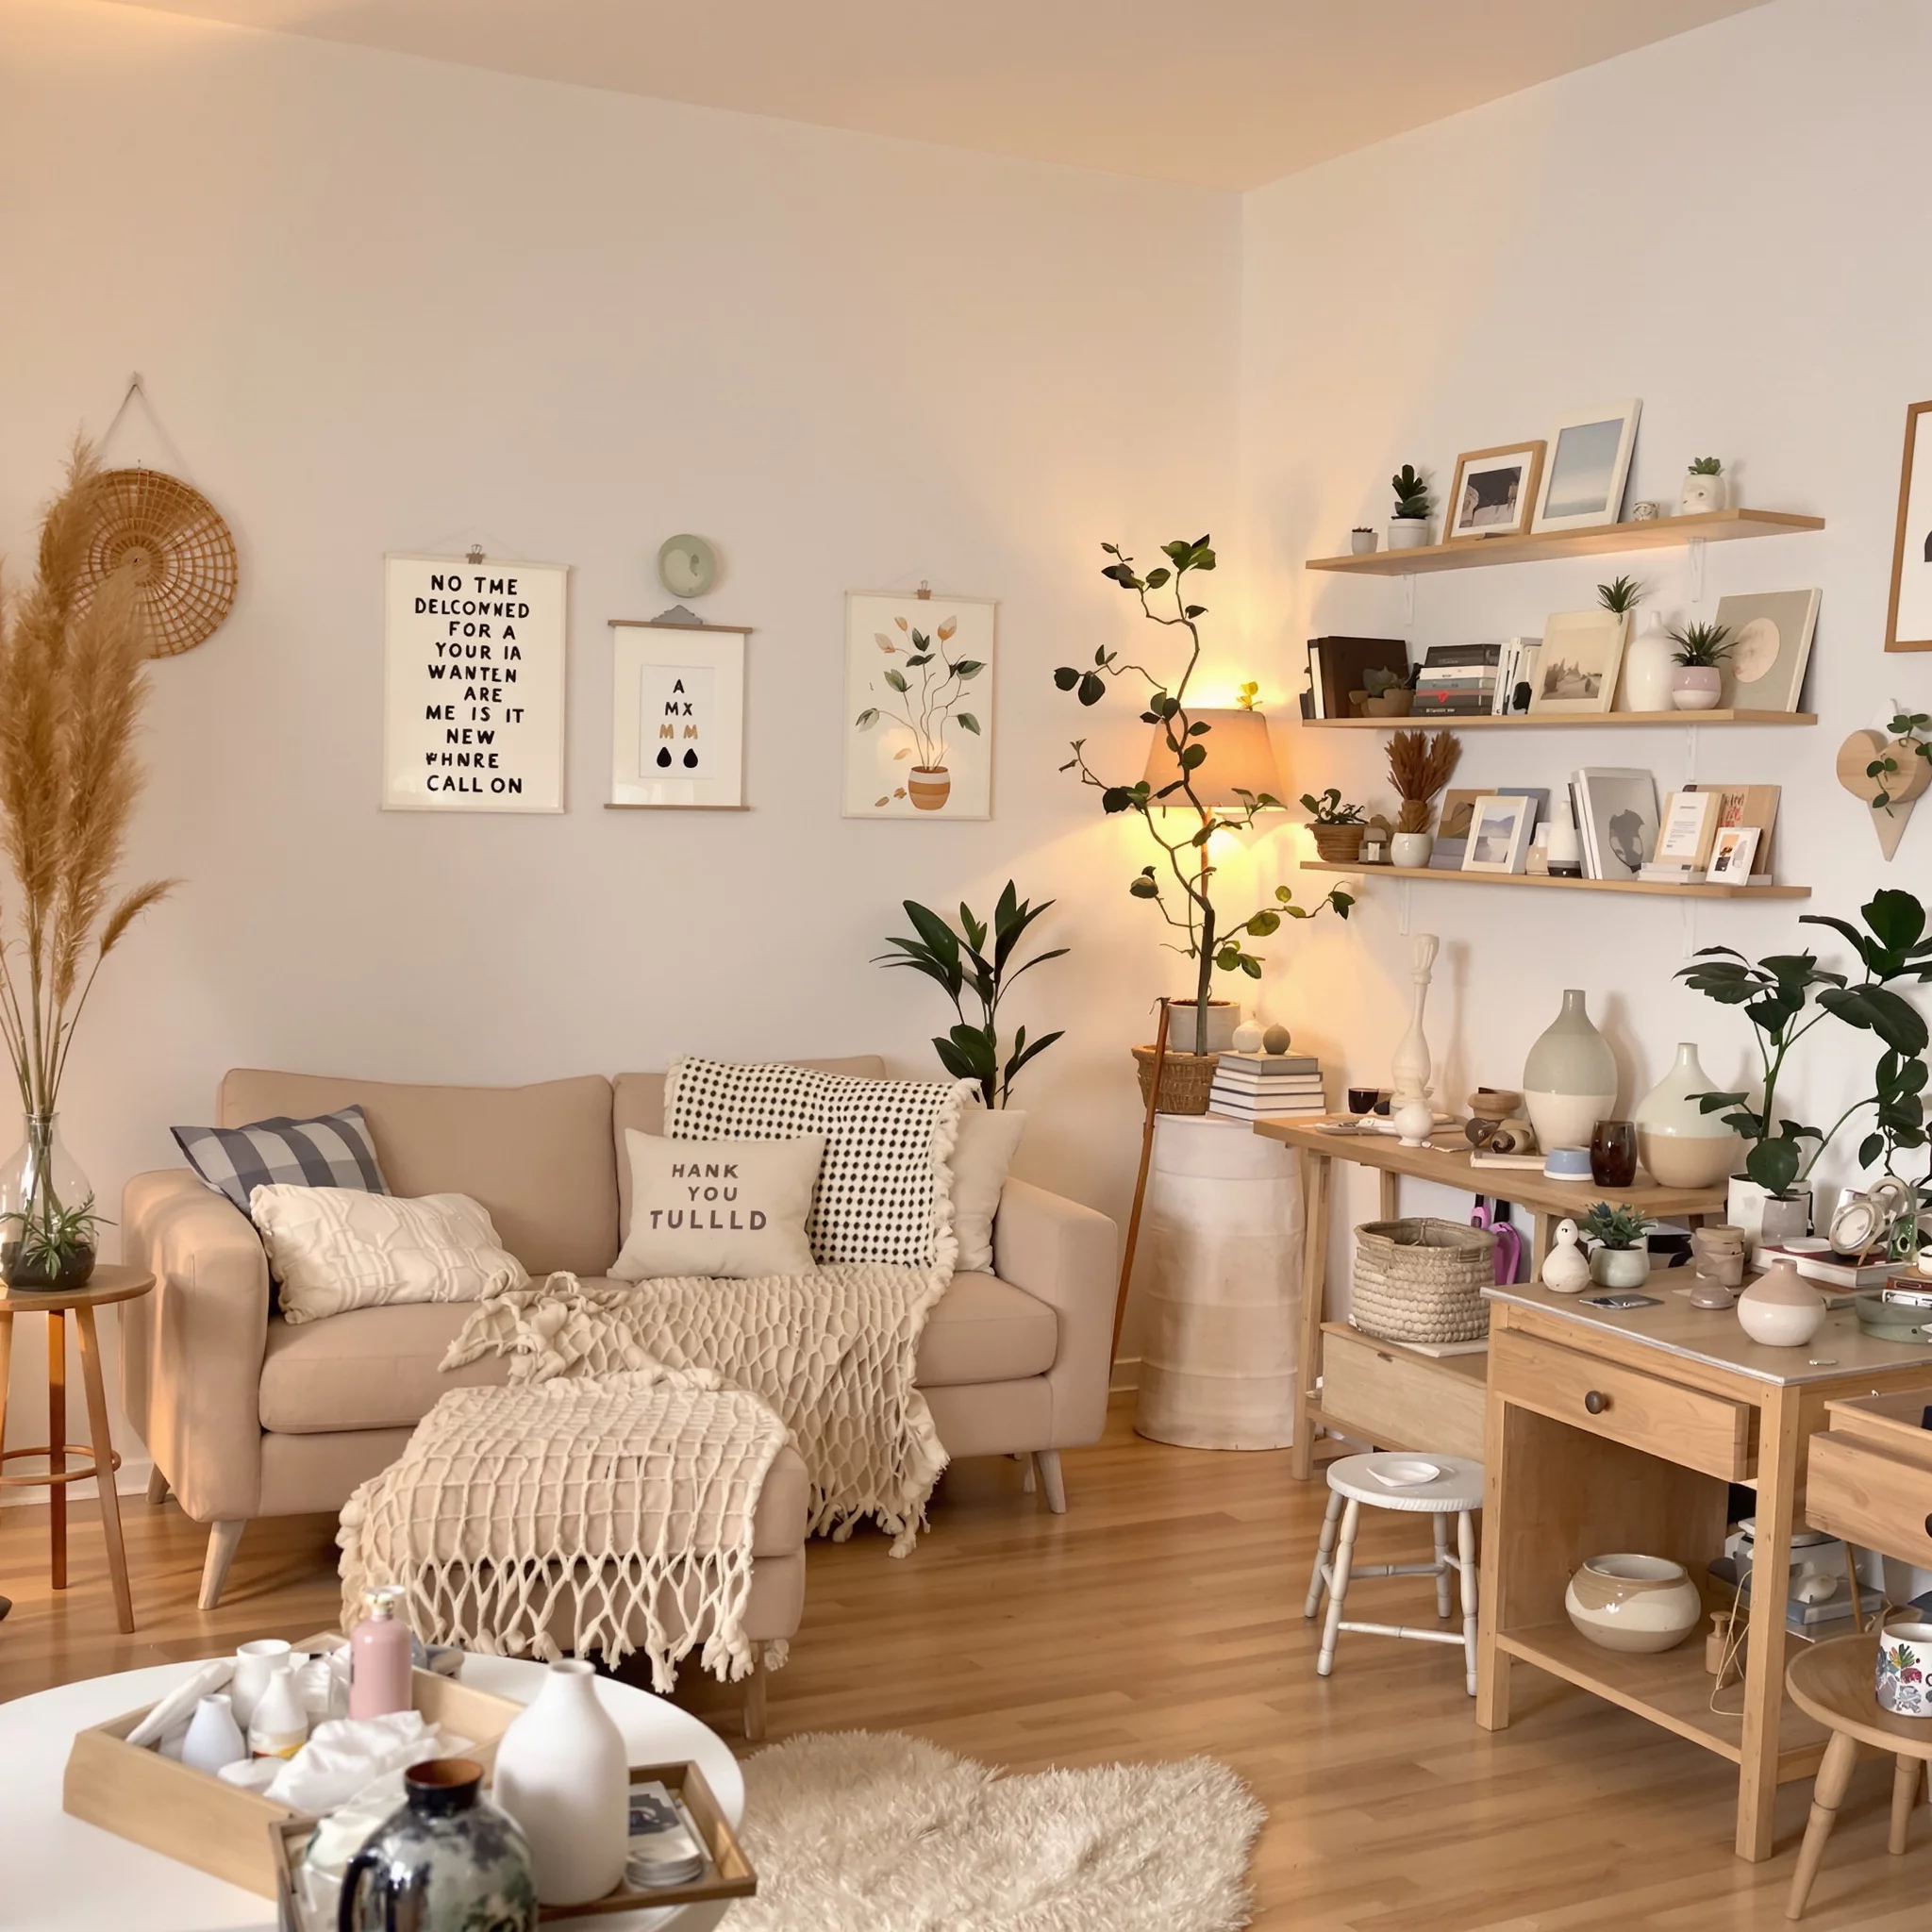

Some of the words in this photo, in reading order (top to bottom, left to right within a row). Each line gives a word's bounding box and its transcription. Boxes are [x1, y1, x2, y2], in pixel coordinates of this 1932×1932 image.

[432, 575, 461, 591] NO
[475, 577, 518, 595] TME
[449, 621, 491, 639] FOR
[503, 625, 515, 640] A
[436, 641, 491, 659] YOUR
[428, 664, 516, 683] WANTEN
[463, 687, 502, 703] ARE
[673, 678, 685, 694] A
[425, 705, 455, 721] ME
[472, 707, 491, 722] IS
[507, 708, 525, 724] IT
[446, 728, 495, 745] NEW
[426, 774, 484, 793] CALL
[491, 777, 523, 794] ON
[672, 1163, 739, 1178] HANK
[688, 1186, 738, 1202] YOU
[650, 1209, 767, 1231] TULLLD
